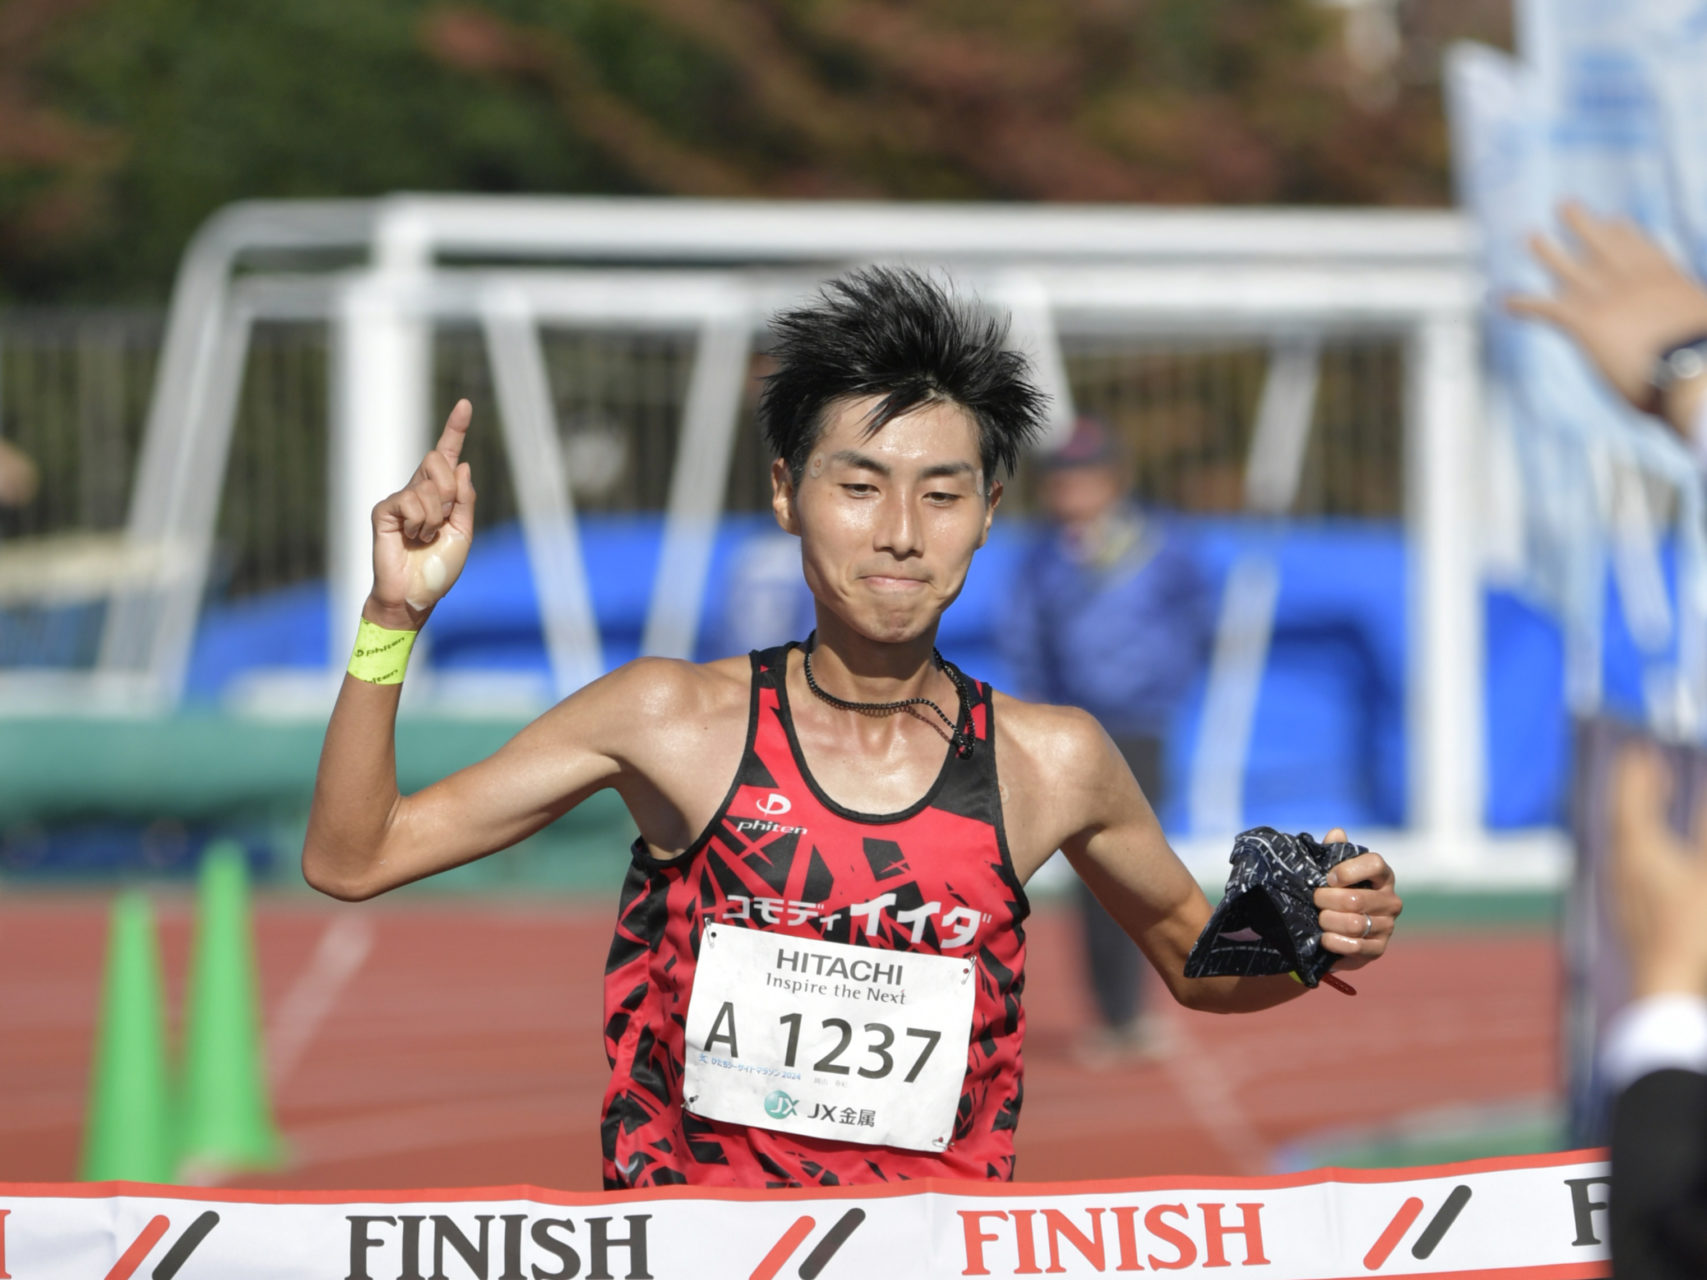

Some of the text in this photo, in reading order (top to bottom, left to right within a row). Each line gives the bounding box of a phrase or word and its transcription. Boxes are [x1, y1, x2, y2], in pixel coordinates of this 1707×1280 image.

[736, 819, 808, 836] phiten
[776, 949, 903, 985] HITACHI
[766, 972, 907, 1005] Inspire the Next
[703, 1001, 942, 1083] A 1237
[956, 1202, 1271, 1277] FINISH
